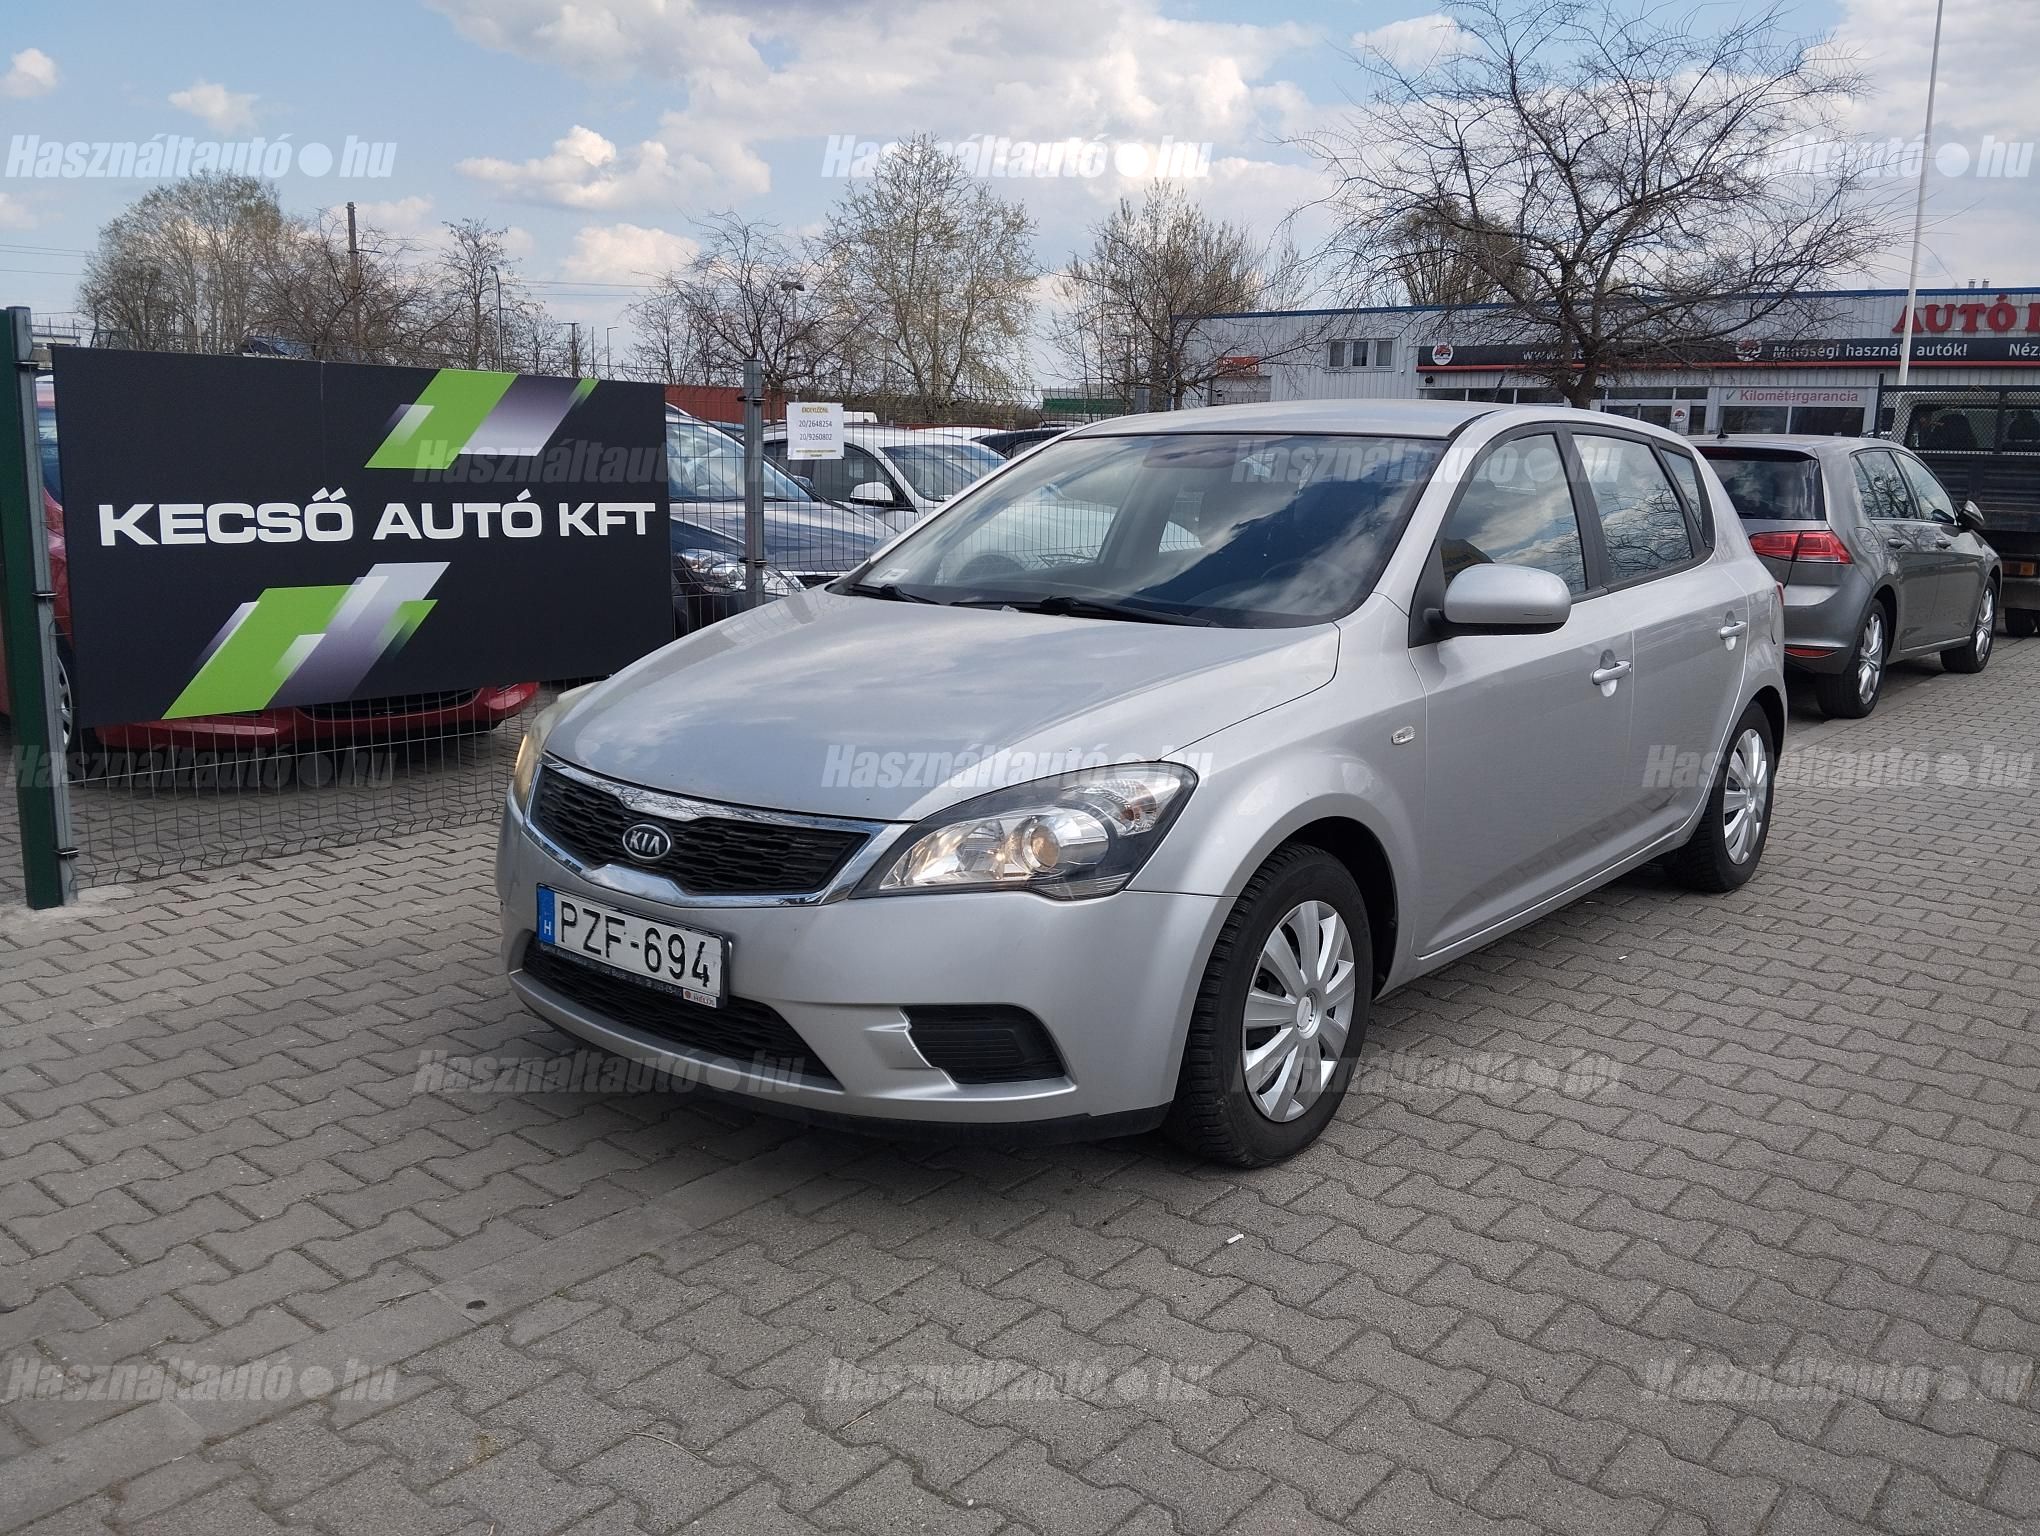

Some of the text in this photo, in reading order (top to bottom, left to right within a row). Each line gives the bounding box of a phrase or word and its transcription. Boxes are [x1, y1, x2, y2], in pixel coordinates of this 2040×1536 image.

[1846, 344, 1903, 358] használ
[1917, 344, 1968, 357] autók!
[2009, 344, 2040, 357] Néz
[1740, 389, 1858, 404] Kilométergarancia
[99, 487, 656, 547] KECSŐ AUTÓ KFT
[629, 831, 661, 855] KIA
[560, 900, 710, 988] PZF-694
